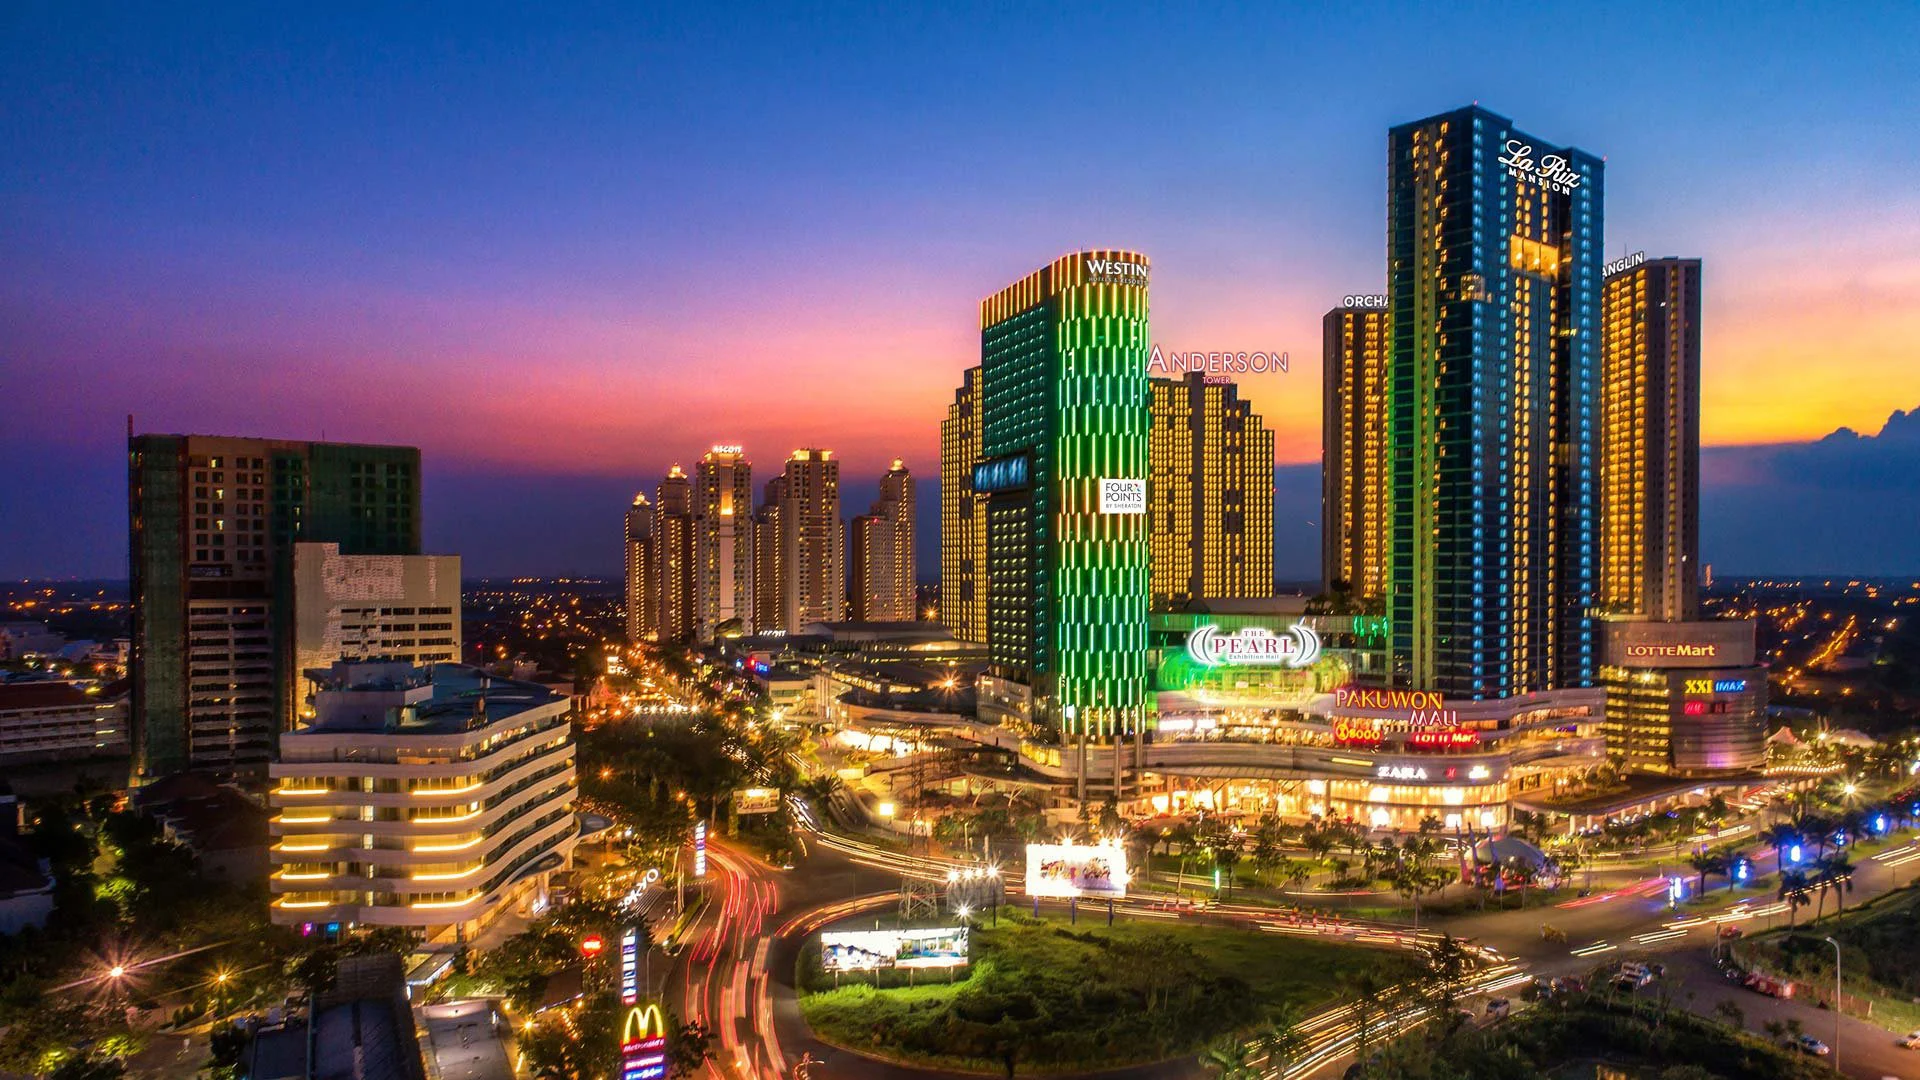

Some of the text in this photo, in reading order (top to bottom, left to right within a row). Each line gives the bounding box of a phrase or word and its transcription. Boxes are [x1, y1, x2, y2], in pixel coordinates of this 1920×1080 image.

[1498, 140, 1581, 188] La Riz
[1508, 166, 1570, 196] MANSION
[1086, 259, 1148, 277] WESTIN
[1146, 343, 1289, 372] ANDERSON
[1203, 376, 1231, 384] TOWER
[1105, 482, 1133, 492] FOUR
[1105, 492, 1142, 501] POINTS
[1213, 638, 1295, 654] PEARL
[1627, 644, 1716, 656] LOTTEMart
[1684, 680, 1713, 694] XXI
[1335, 689, 1443, 710] PAKUWON
[1409, 710, 1460, 726] MALL
[1378, 766, 1428, 780] ZARA
